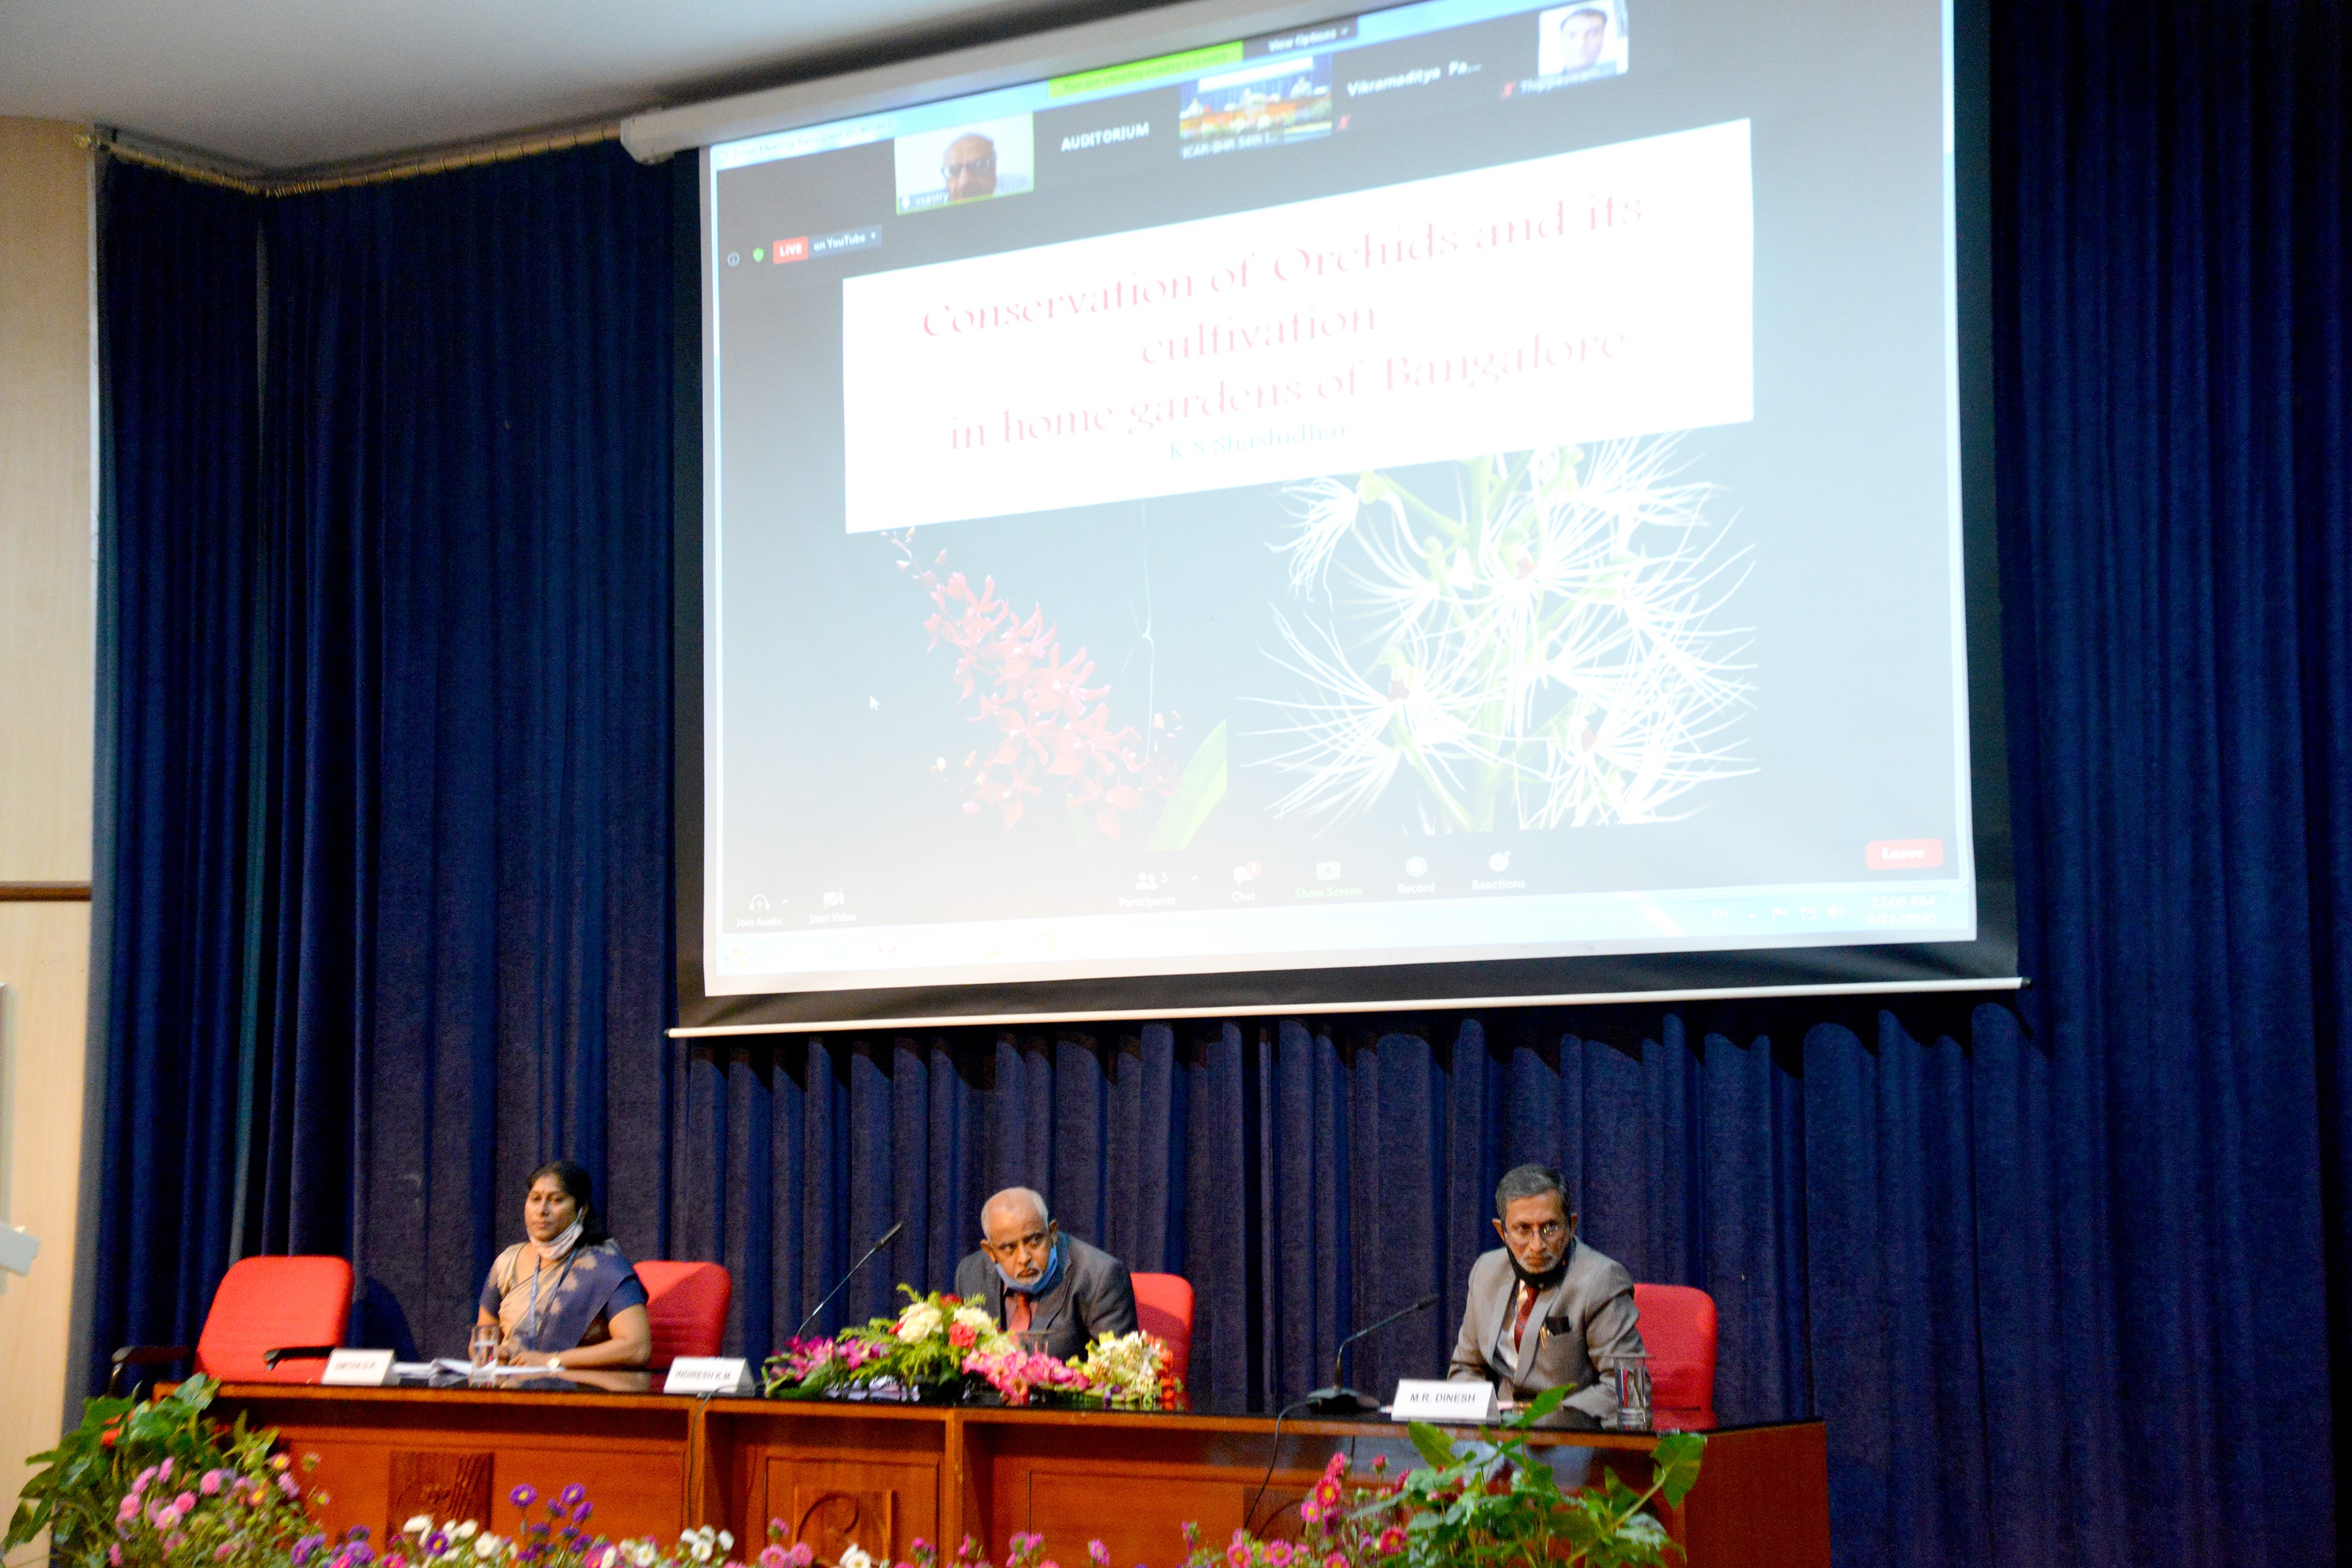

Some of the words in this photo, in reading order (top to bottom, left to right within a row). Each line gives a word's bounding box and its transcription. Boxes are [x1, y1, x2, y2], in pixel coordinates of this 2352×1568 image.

[1268, 38, 1294, 52] View
[1295, 27, 1337, 48] Options
[1060, 122, 1150, 152] AUDITORIUM
[779, 242, 802, 257] LIVE
[813, 240, 826, 252] on
[826, 233, 866, 250] YouTube
[923, 272, 1193, 336] Conservation
[1210, 252, 1256, 293] of
[1273, 223, 1458, 282] Orchids
[1475, 199, 1565, 250] and
[1590, 192, 1643, 231] its
[1141, 304, 1375, 364] cultivation
[951, 416, 986, 449] in
[1003, 406, 1113, 443] home
[1127, 378, 1302, 436] gardens
[1317, 358, 1364, 400] of
[1386, 333, 1626, 389] Bangalore
[1213, 422, 1352, 453] Shashidhar
[1882, 846, 1925, 860] Leave
[1161, 872, 1168, 883] 5
[1471, 877, 1526, 892] Reactions
[1294, 887, 1325, 900] Share
[1327, 885, 1363, 898] Screen
[1397, 881, 1435, 894] Record
[1119, 894, 1176, 909] Participants
[1232, 890, 1256, 902] Chat
[1910, 895, 1936, 908] PM
[809, 913, 830, 924] Start
[832, 911, 858, 923] Video
[1711, 907, 1729, 920] EN
[735, 916, 755, 928] Join
[756, 915, 783, 927] Audio
[674, 1370, 714, 1380] INDIRESH
[1410, 1392, 1431, 1403] M.R.
[1435, 1392, 1476, 1403] DINESH
